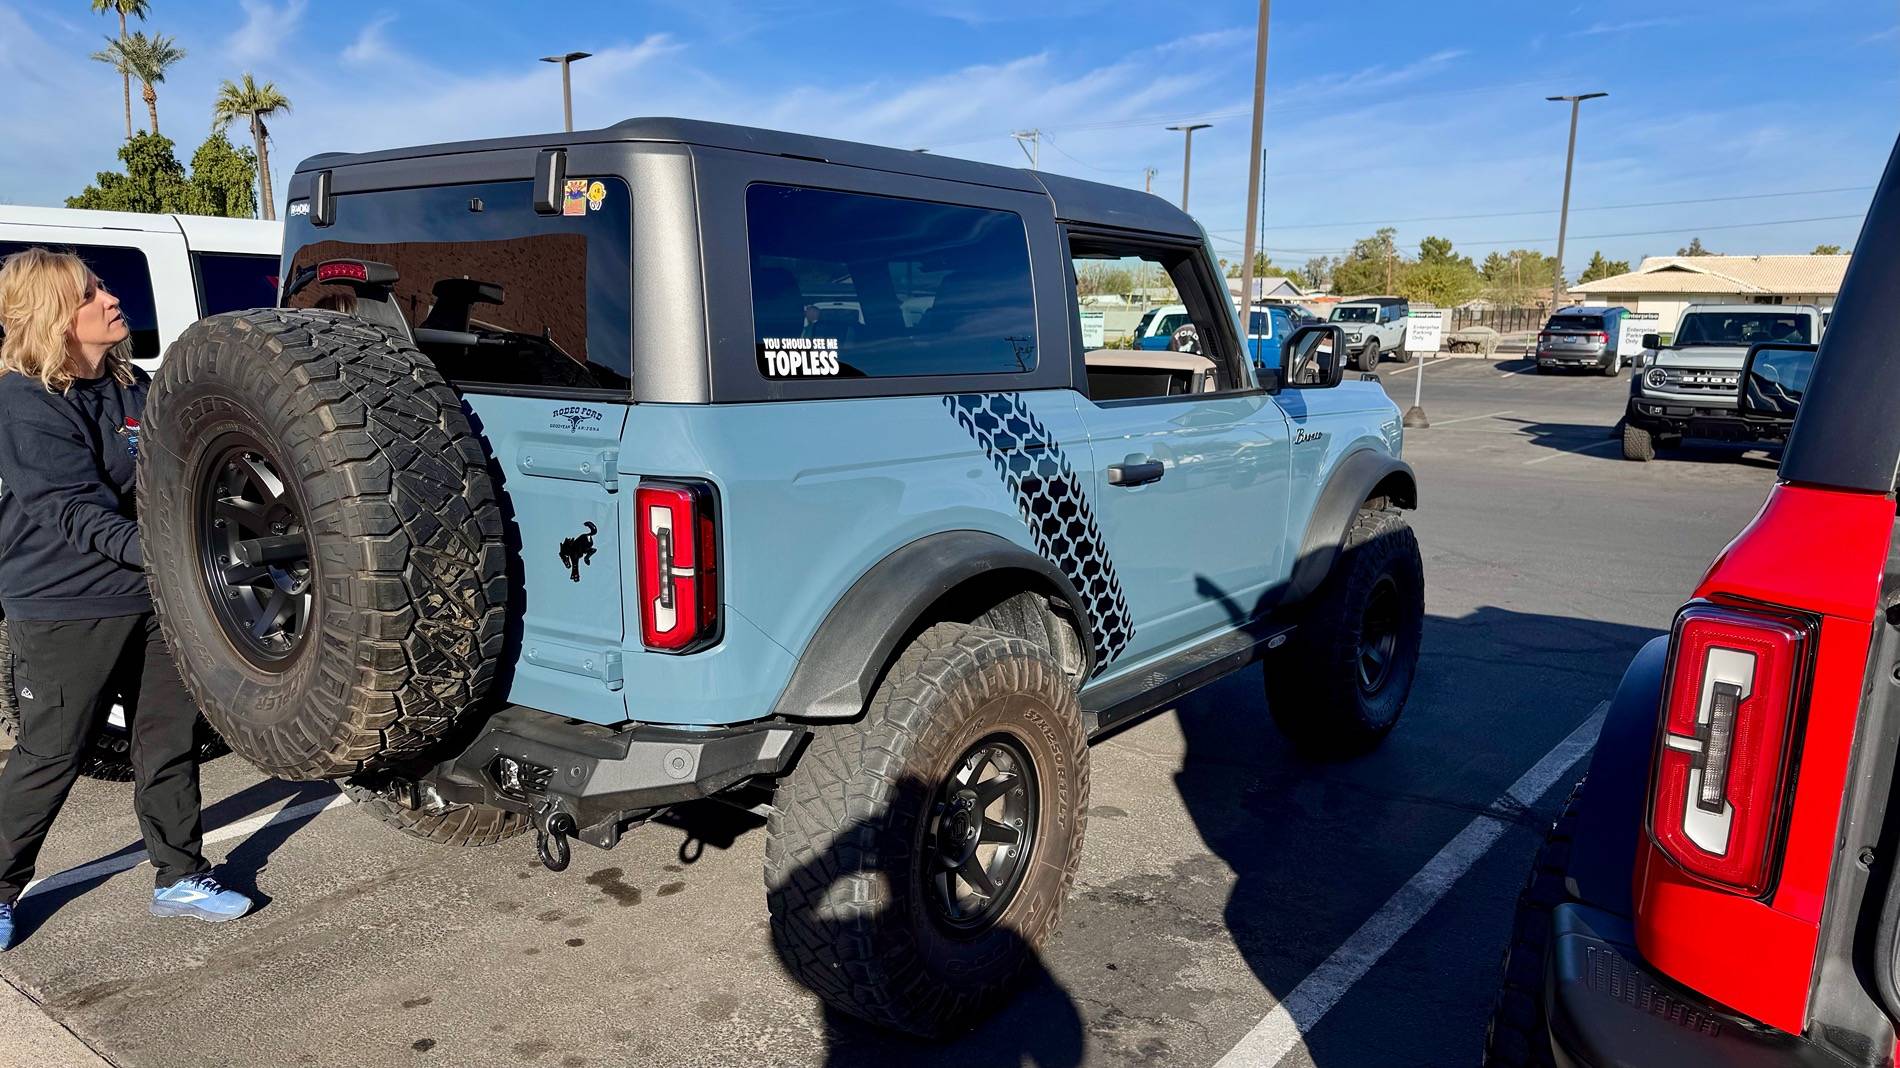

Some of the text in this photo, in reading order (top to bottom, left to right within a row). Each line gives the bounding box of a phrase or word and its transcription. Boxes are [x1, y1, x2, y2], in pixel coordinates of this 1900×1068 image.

[1174, 330, 1200, 341] FORD
[763, 337, 839, 350] YOU SHOULD SEE ME
[764, 350, 840, 376] TOPLESS
[1683, 375, 1739, 384] BRON
[552, 406, 603, 421] RODEO FORD
